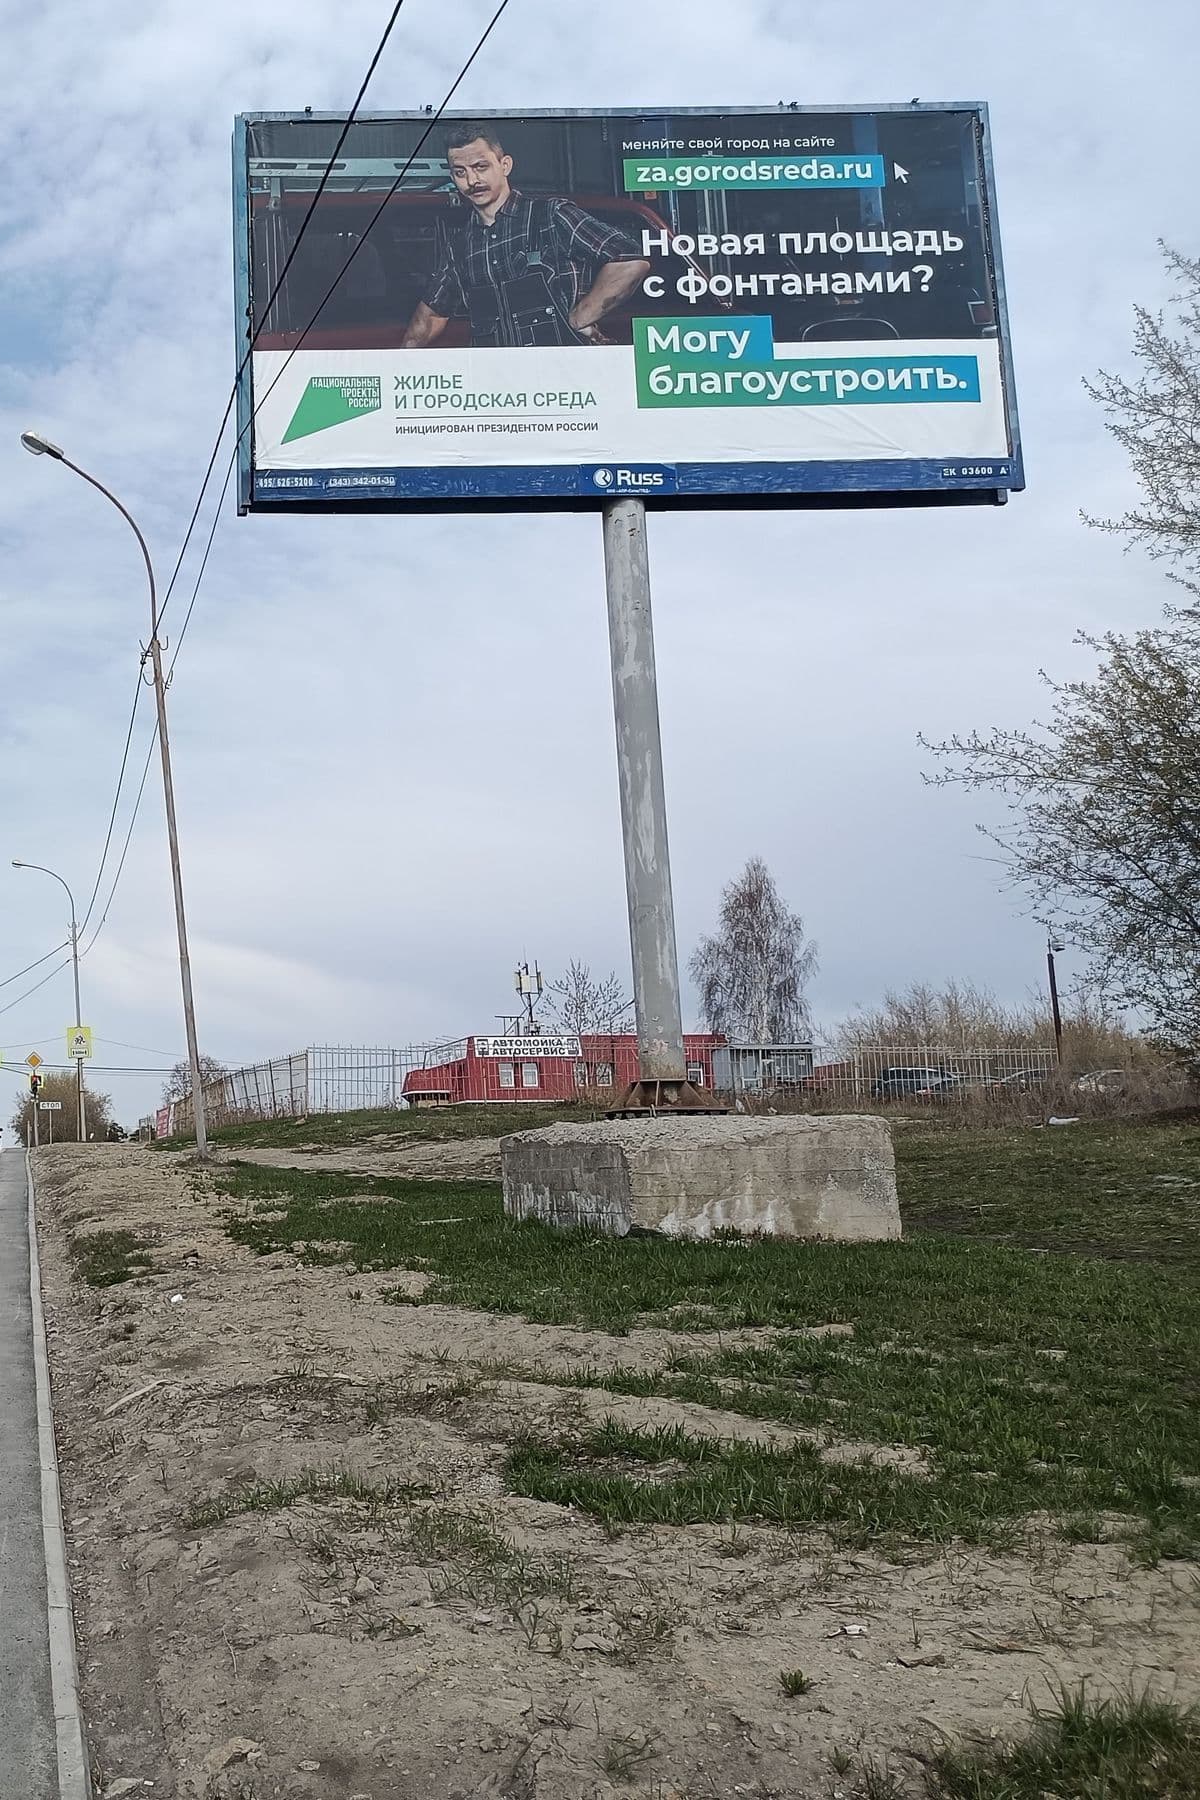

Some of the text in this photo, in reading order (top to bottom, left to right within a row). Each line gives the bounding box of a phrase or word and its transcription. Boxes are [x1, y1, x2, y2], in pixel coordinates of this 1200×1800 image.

[622, 135, 835, 151] меняйте свой город на сайте
[636, 159, 873, 187] za.gorodsreda.ru
[642, 229, 964, 259] Новая площадь
[643, 264, 934, 304] с фонтанами?
[646, 325, 750, 359] Могу
[311, 377, 380, 388] НАЦИОНАЛЬНЫЕ
[394, 375, 462, 390] ЖИЛЬЕ
[649, 364, 968, 401] благоустроить.
[341, 387, 380, 398] ПРОЕКТЫ
[348, 398, 380, 408] РОССИИ
[395, 391, 597, 411] И ГОРОДСКАЯ СРЕДА
[395, 422, 599, 435] ИНИЦИИРОВАН ПРЕЗИДЕНТОМ РОССИИ
[617, 470, 663, 486] Russ
[961, 466, 993, 475] 03600
[492, 1047, 566, 1056] АВТОСЕРВИС
